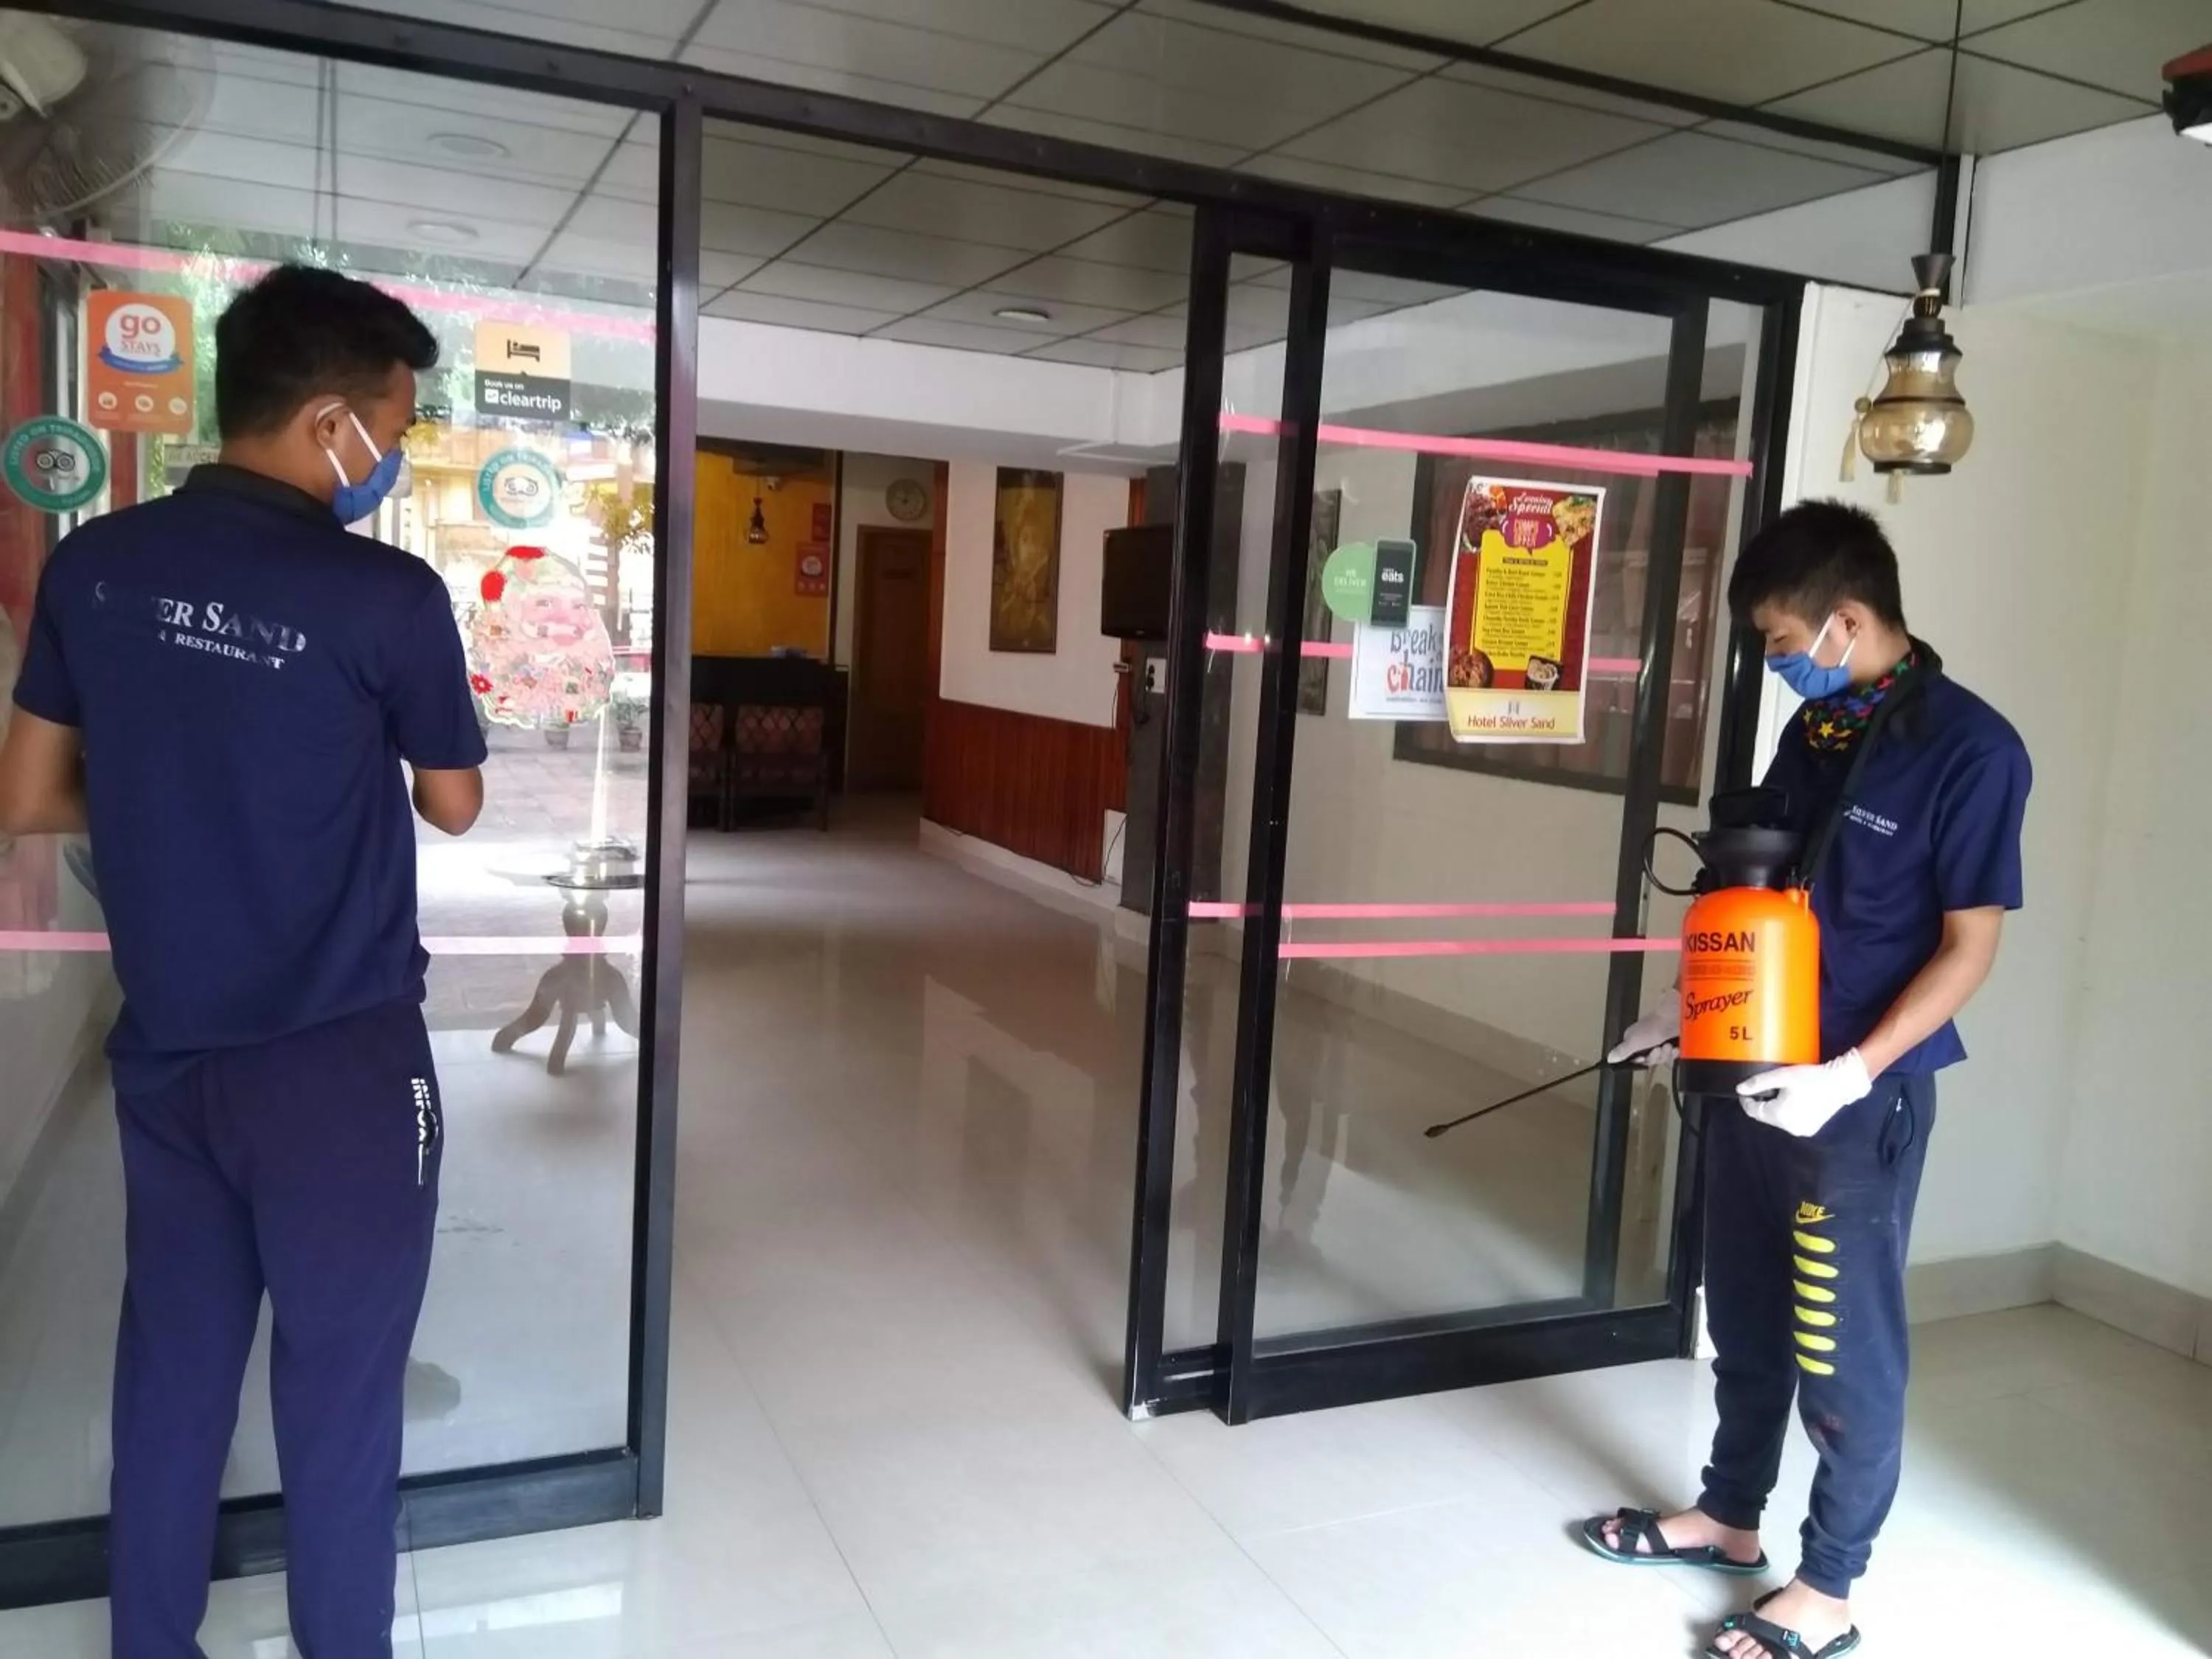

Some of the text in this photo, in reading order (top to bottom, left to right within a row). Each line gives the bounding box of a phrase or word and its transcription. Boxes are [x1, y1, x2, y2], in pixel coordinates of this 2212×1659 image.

[120, 314, 161, 339] go
[500, 390, 562, 413] cleartrip
[1381, 571, 1405, 584] eats
[202, 601, 307, 653] SAND
[1468, 714, 1555, 730] Hotel Silver Sand
[1685, 931, 1756, 953] KISSAN
[1685, 990, 1754, 1021] Sprayer
[1800, 1200, 1826, 1219] NIKE
